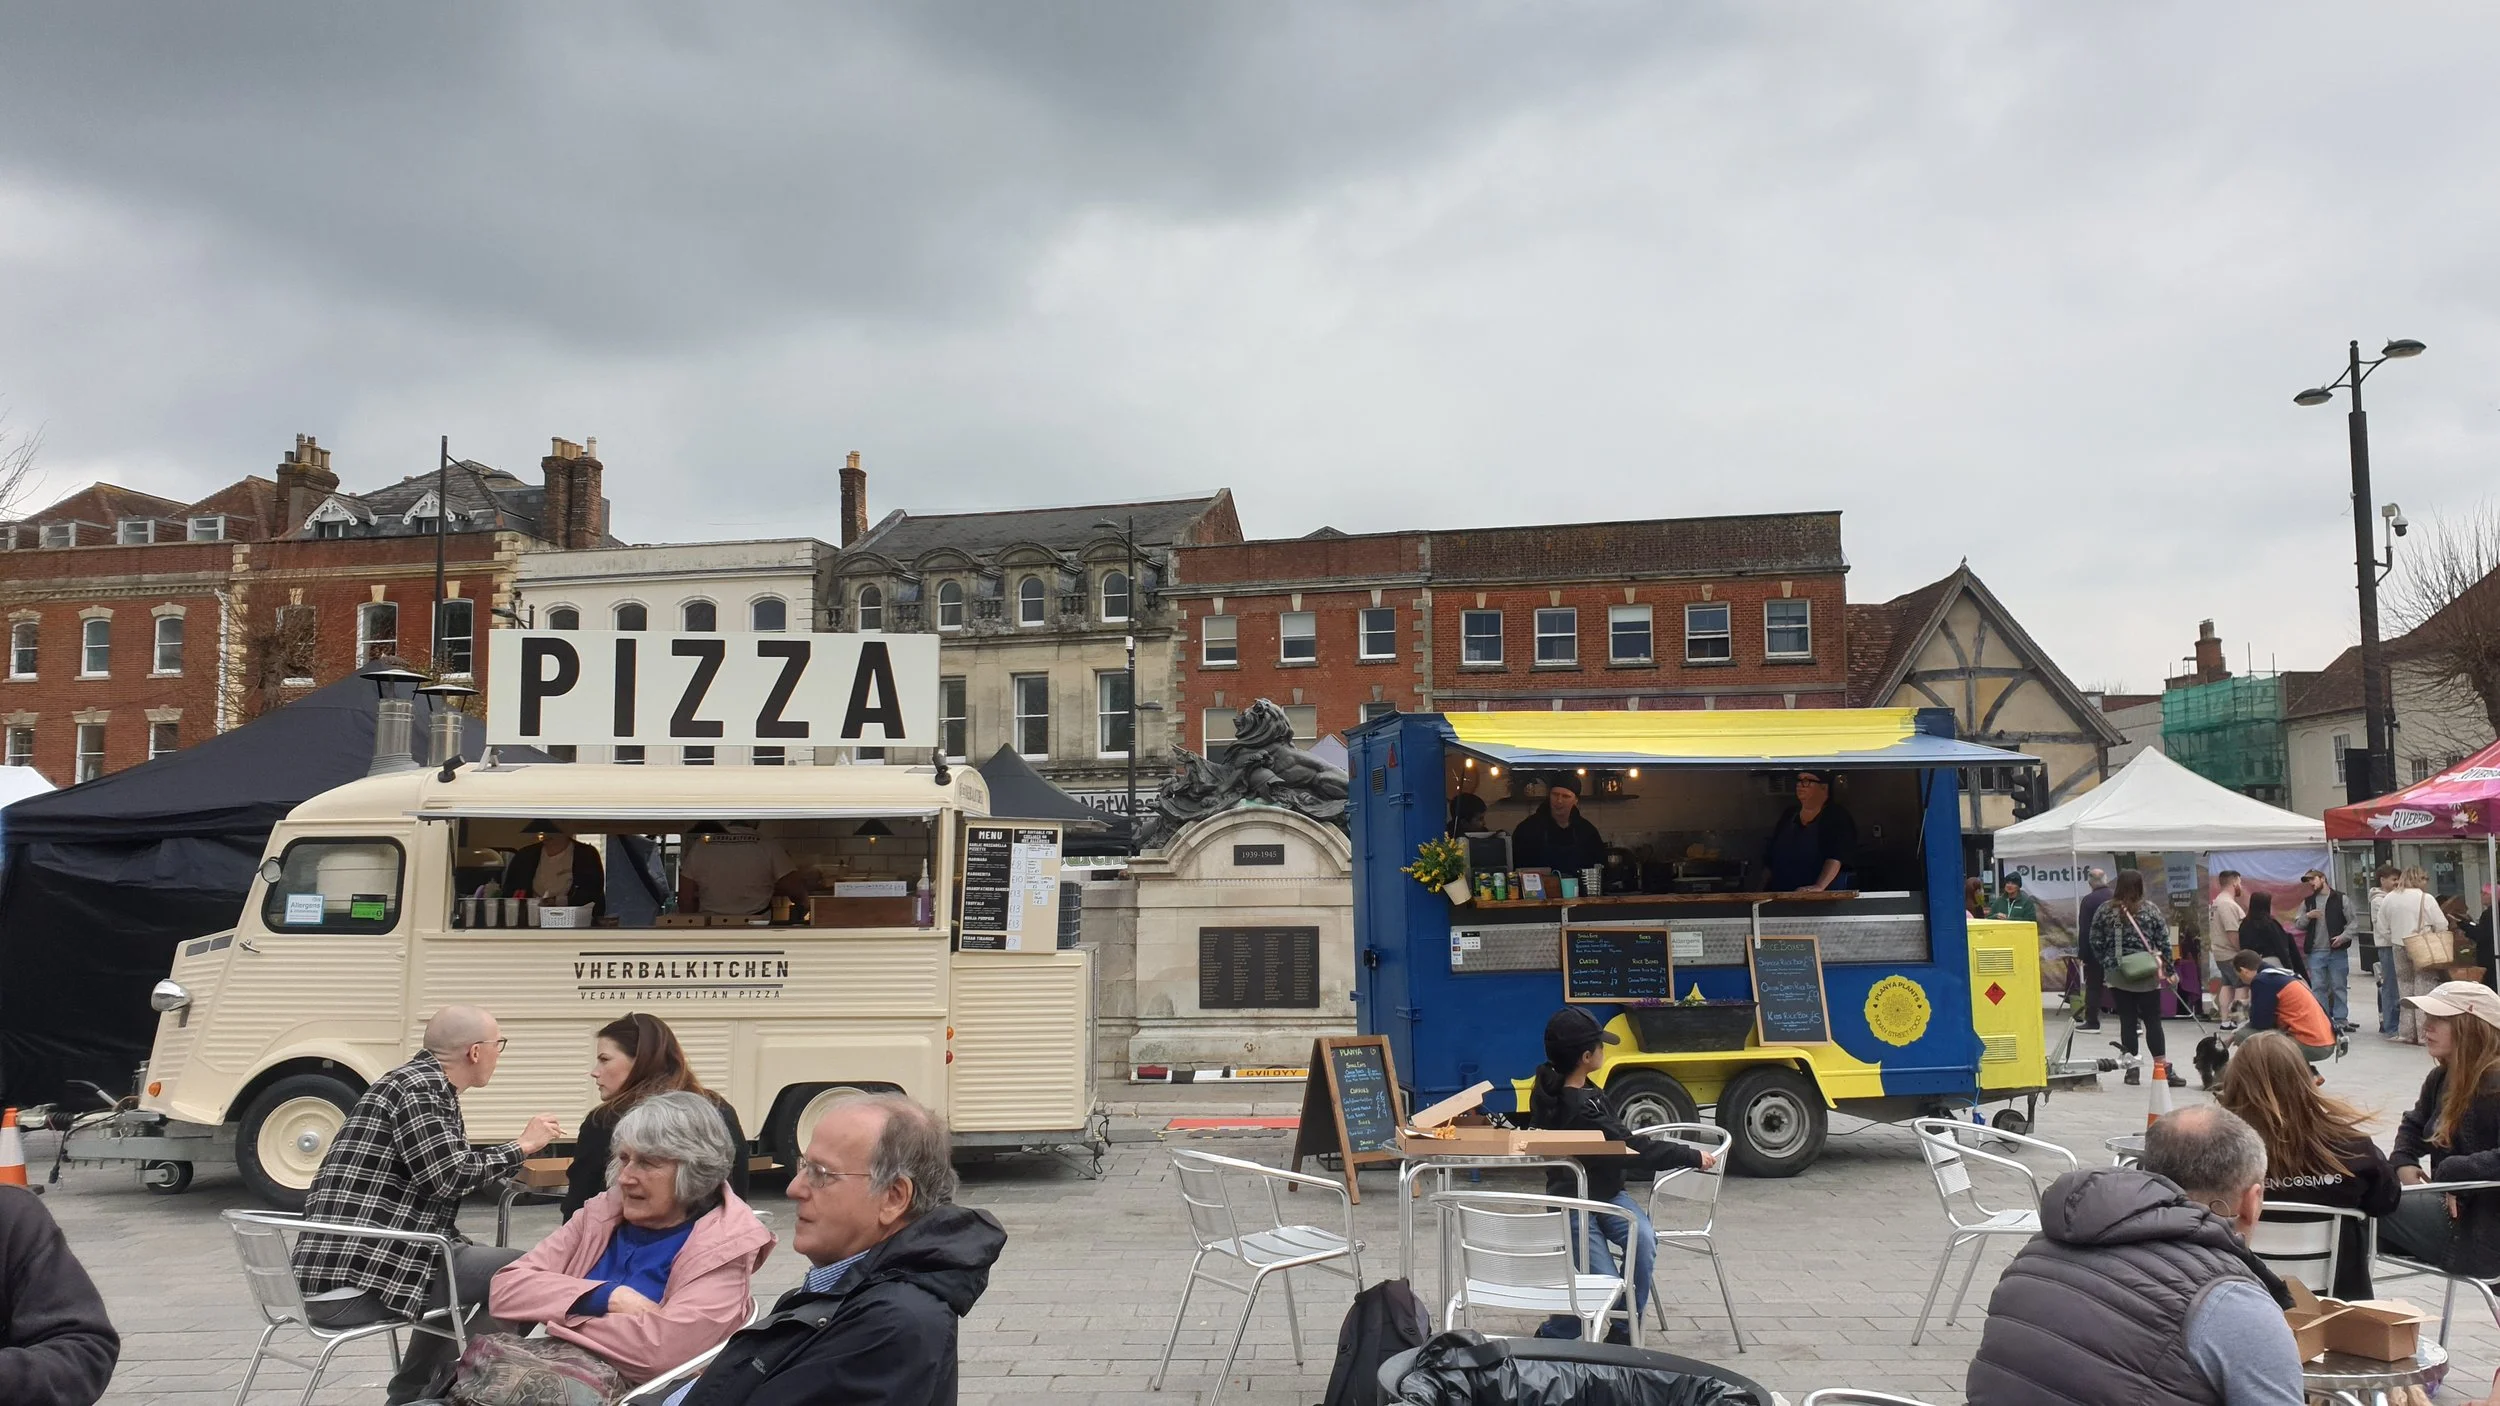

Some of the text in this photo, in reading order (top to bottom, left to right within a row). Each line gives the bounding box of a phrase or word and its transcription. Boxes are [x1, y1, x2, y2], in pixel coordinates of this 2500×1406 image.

[519, 636, 906, 739] PIZZA
[978, 831, 1002, 840] MENU
[1242, 850, 1276, 858] 1939-1945
[2016, 865, 2090, 881] Plantlif
[574, 960, 789, 979] VHERBALKITCHEN
[580, 992, 626, 1000] VEGAN
[637, 991, 728, 1000] NEAPOLITAN
[1875, 981, 1920, 1002] PLANYA PLANTS
[2282, 1173, 2342, 1188] COSMOS
